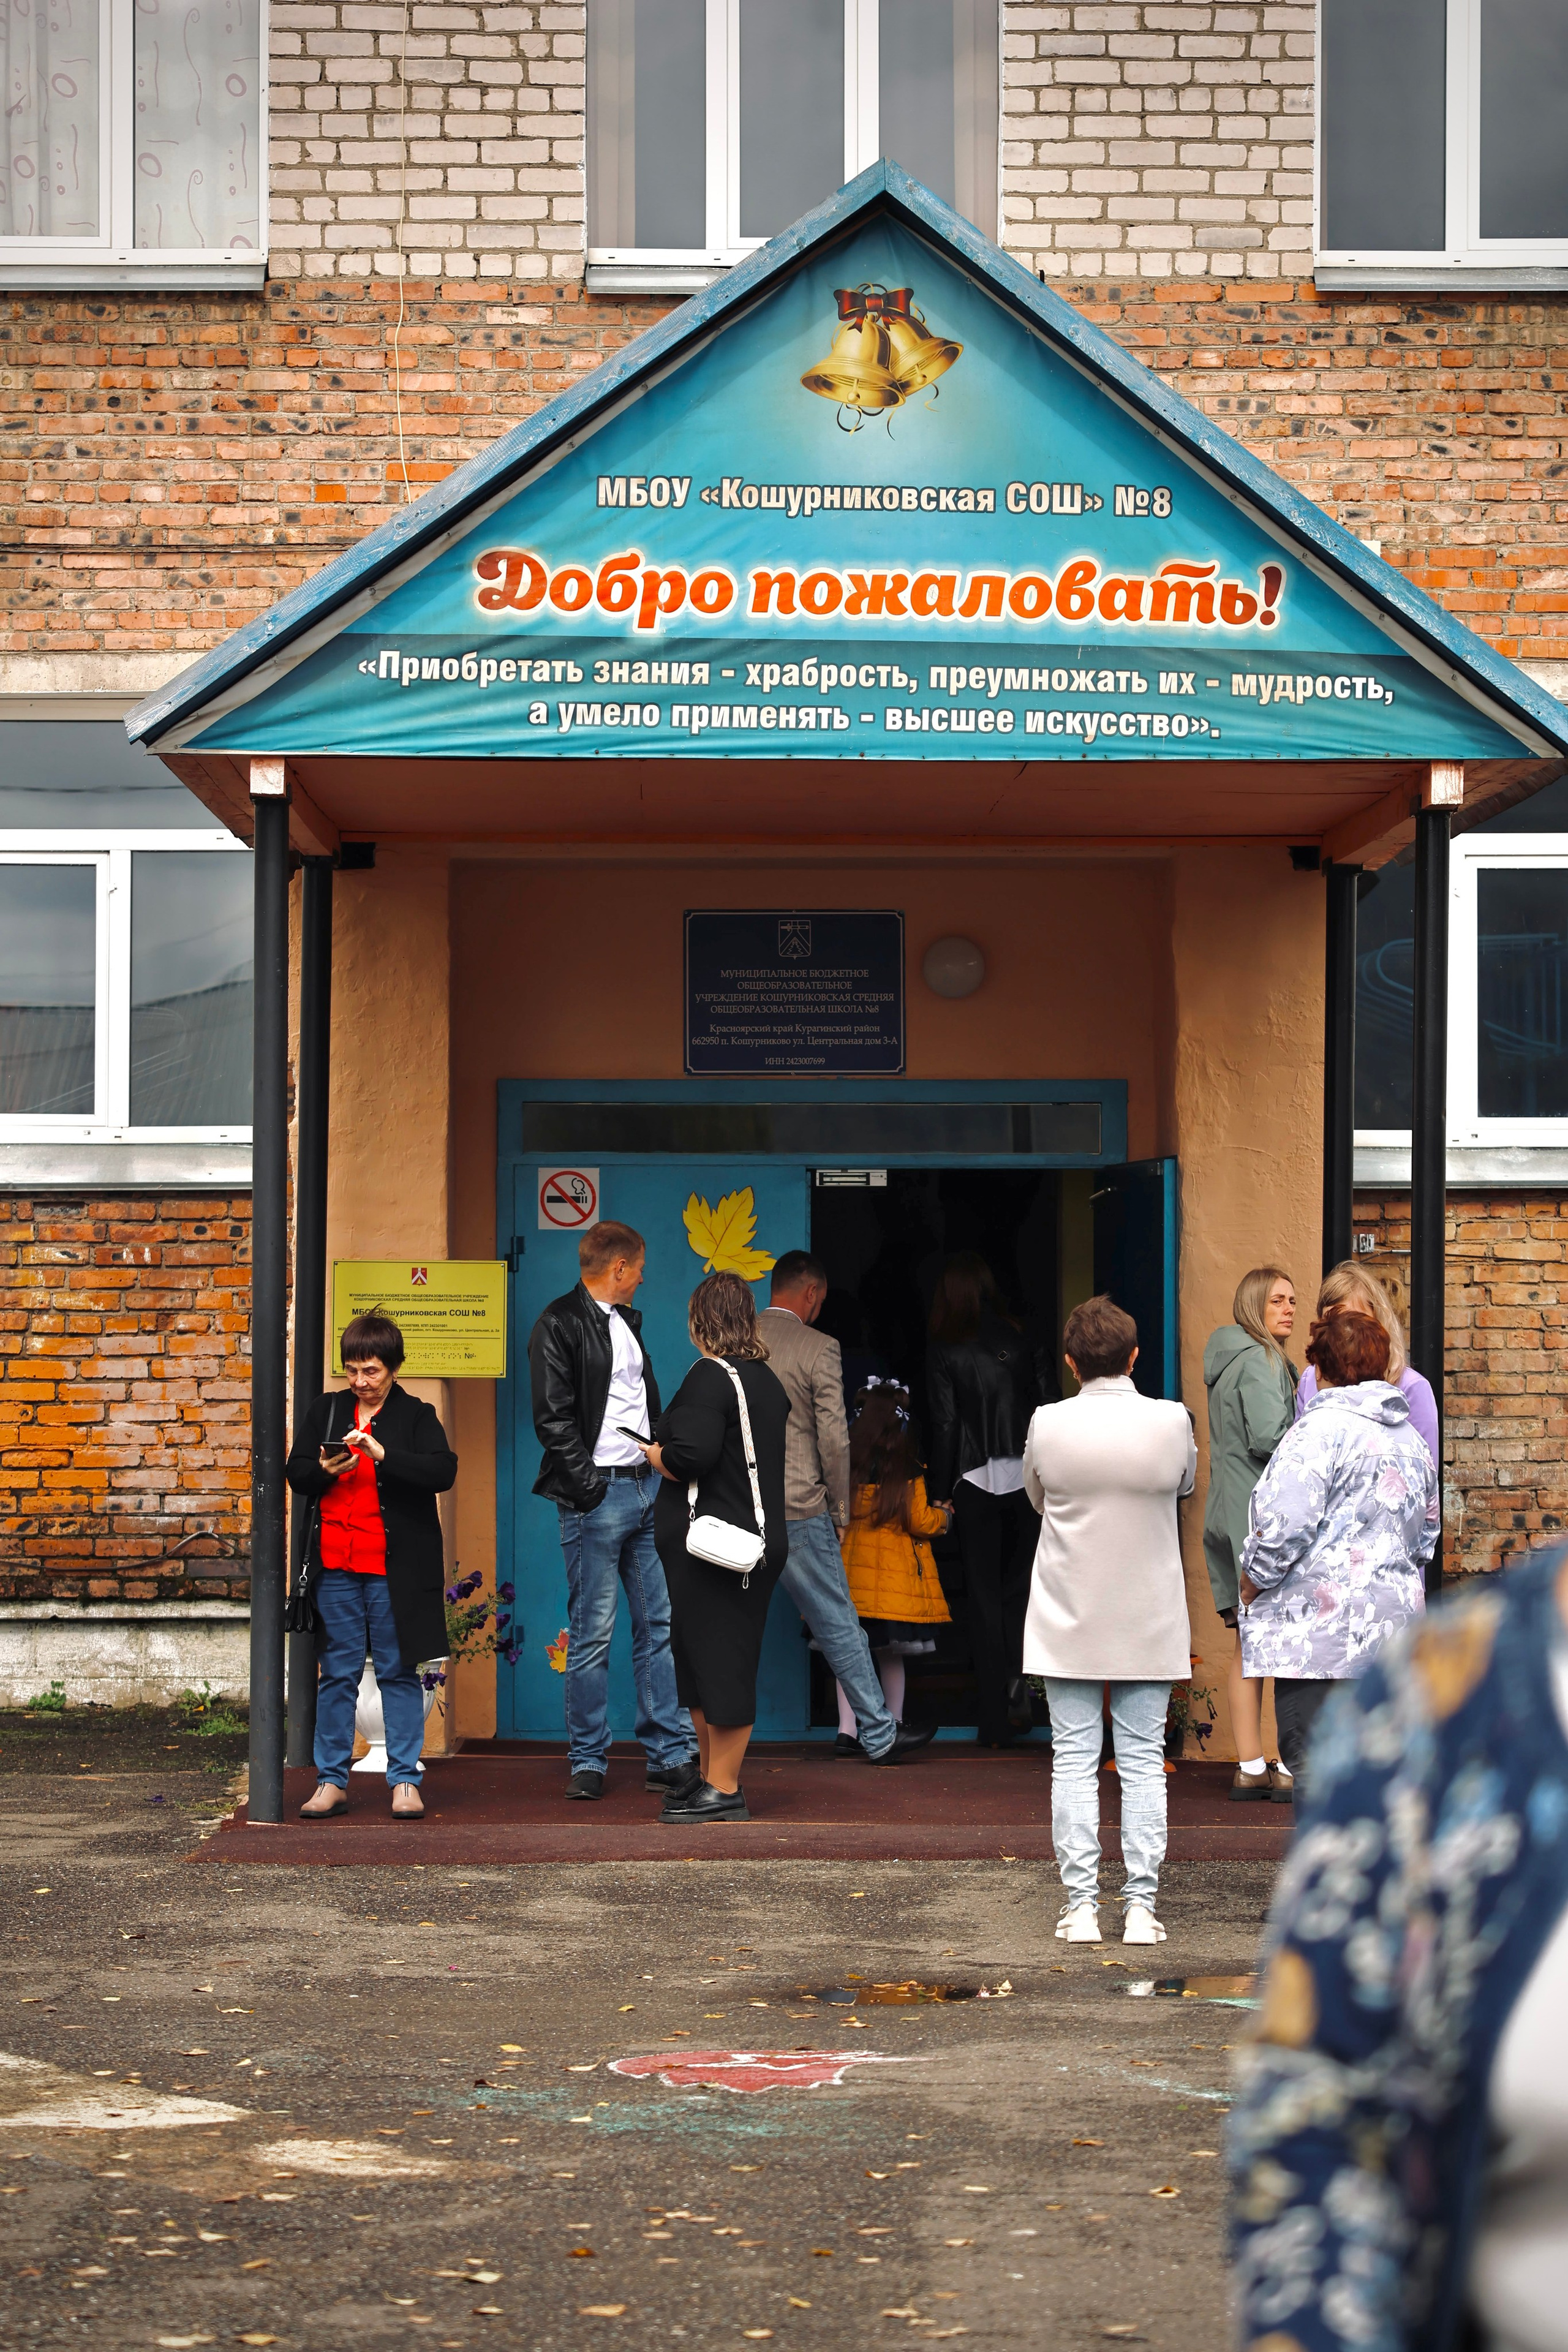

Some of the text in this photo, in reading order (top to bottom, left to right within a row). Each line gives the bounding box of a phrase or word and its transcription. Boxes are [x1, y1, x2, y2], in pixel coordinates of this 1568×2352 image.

[598, 477, 1171, 518] МБОУ «Кошурниковская СОШ» №8
[475, 549, 1283, 630] Добро пожаловать!
[358, 650, 584, 688] «Приобретать
[593, 660, 710, 687] знания
[744, 656, 918, 694] храбрость,
[929, 666, 1148, 698] преумножать
[1158, 671, 1196, 695] их
[1231, 673, 1393, 706] мудрость,
[529, 703, 548, 725] а
[558, 703, 660, 734] умело
[671, 704, 850, 735] применять
[885, 707, 1014, 733] высшее
[1025, 710, 1220, 744] искусство».
[720, 970, 869, 979] МУНИЦИПАЛЬНОЕ БЮДЖЕТНОЕ
[737, 981, 853, 990] ОБЩЕОБРАЗОВАТЕЛЬНОЕ
[695, 993, 894, 1003] УЧРЕЖДЕНИЕ КОШУРНИКОВСКАЯ СРЕДНЯЯ
[710, 1005, 880, 1014] ОБЩЕОБРАЗОВАТЕЛЬНАЯ ШКОЛА №8
[709, 1024, 880, 1035] Красноярский край Курагинский район
[692, 1036, 720, 1046] 662950
[731, 1036, 791, 1048] Кошурниково
[793, 1038, 805, 1047] ул.
[807, 1036, 863, 1048] Центральная
[883, 1036, 898, 1045] 3-А
[379, 1308, 447, 1317] Кошурниковская
